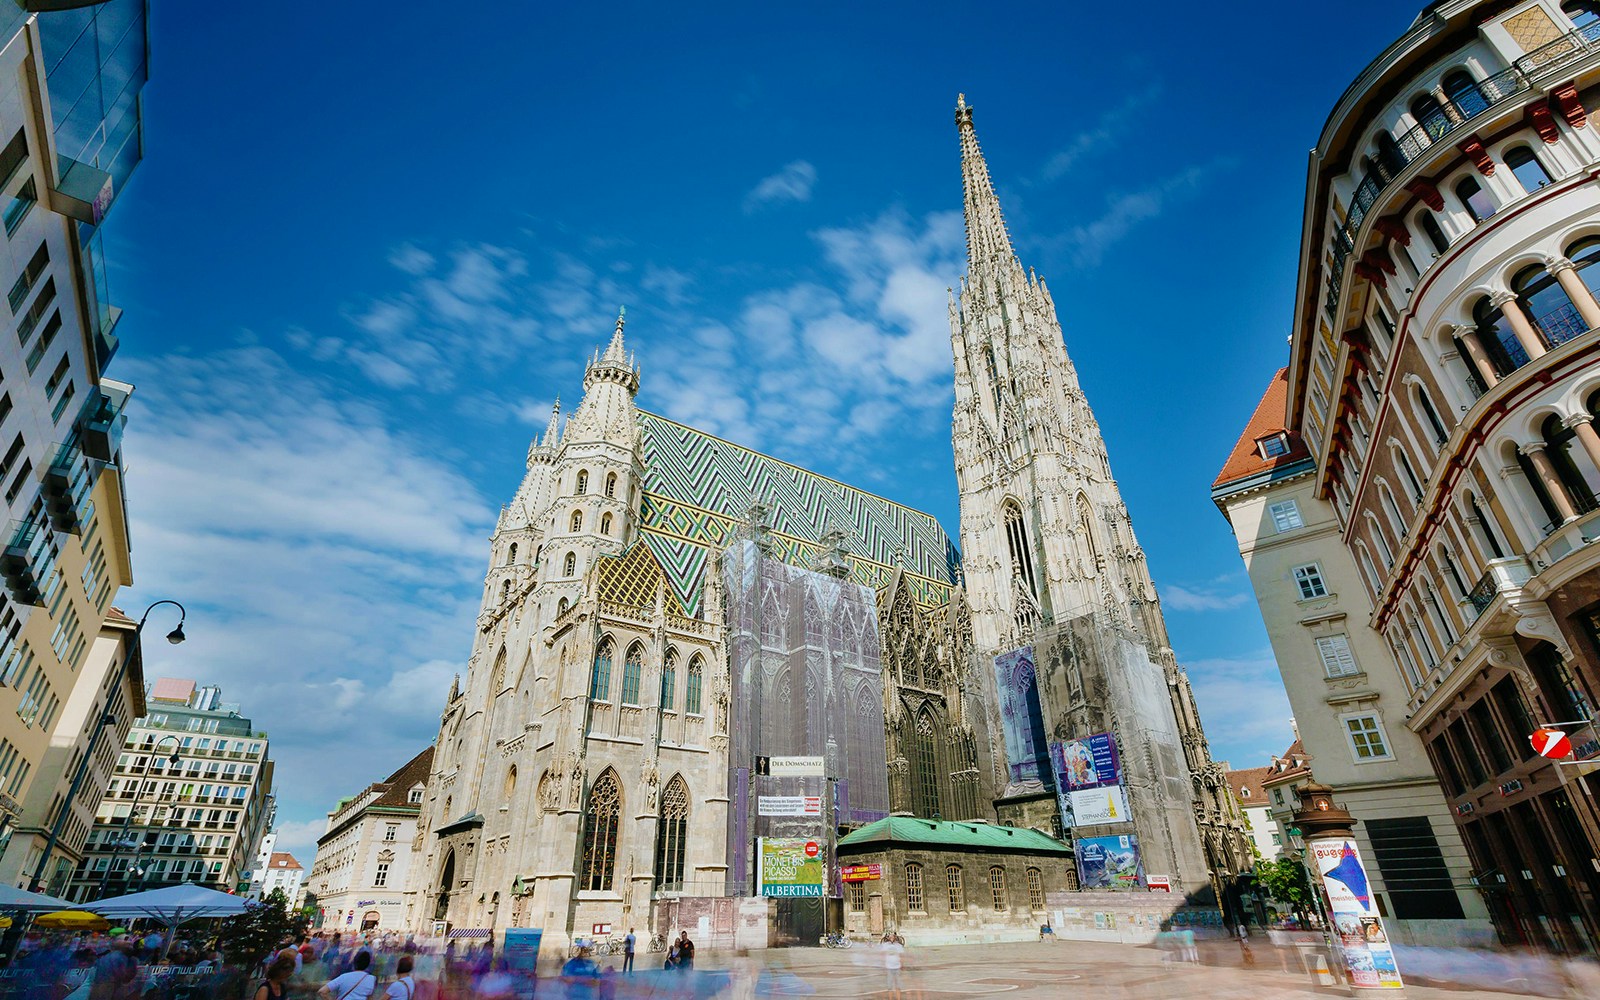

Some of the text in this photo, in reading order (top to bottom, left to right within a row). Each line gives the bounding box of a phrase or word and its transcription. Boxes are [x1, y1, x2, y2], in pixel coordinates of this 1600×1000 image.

[764, 856, 792, 867] MONET
[764, 866, 797, 877] PICASSO
[764, 885, 820, 896] ALBERTINA
